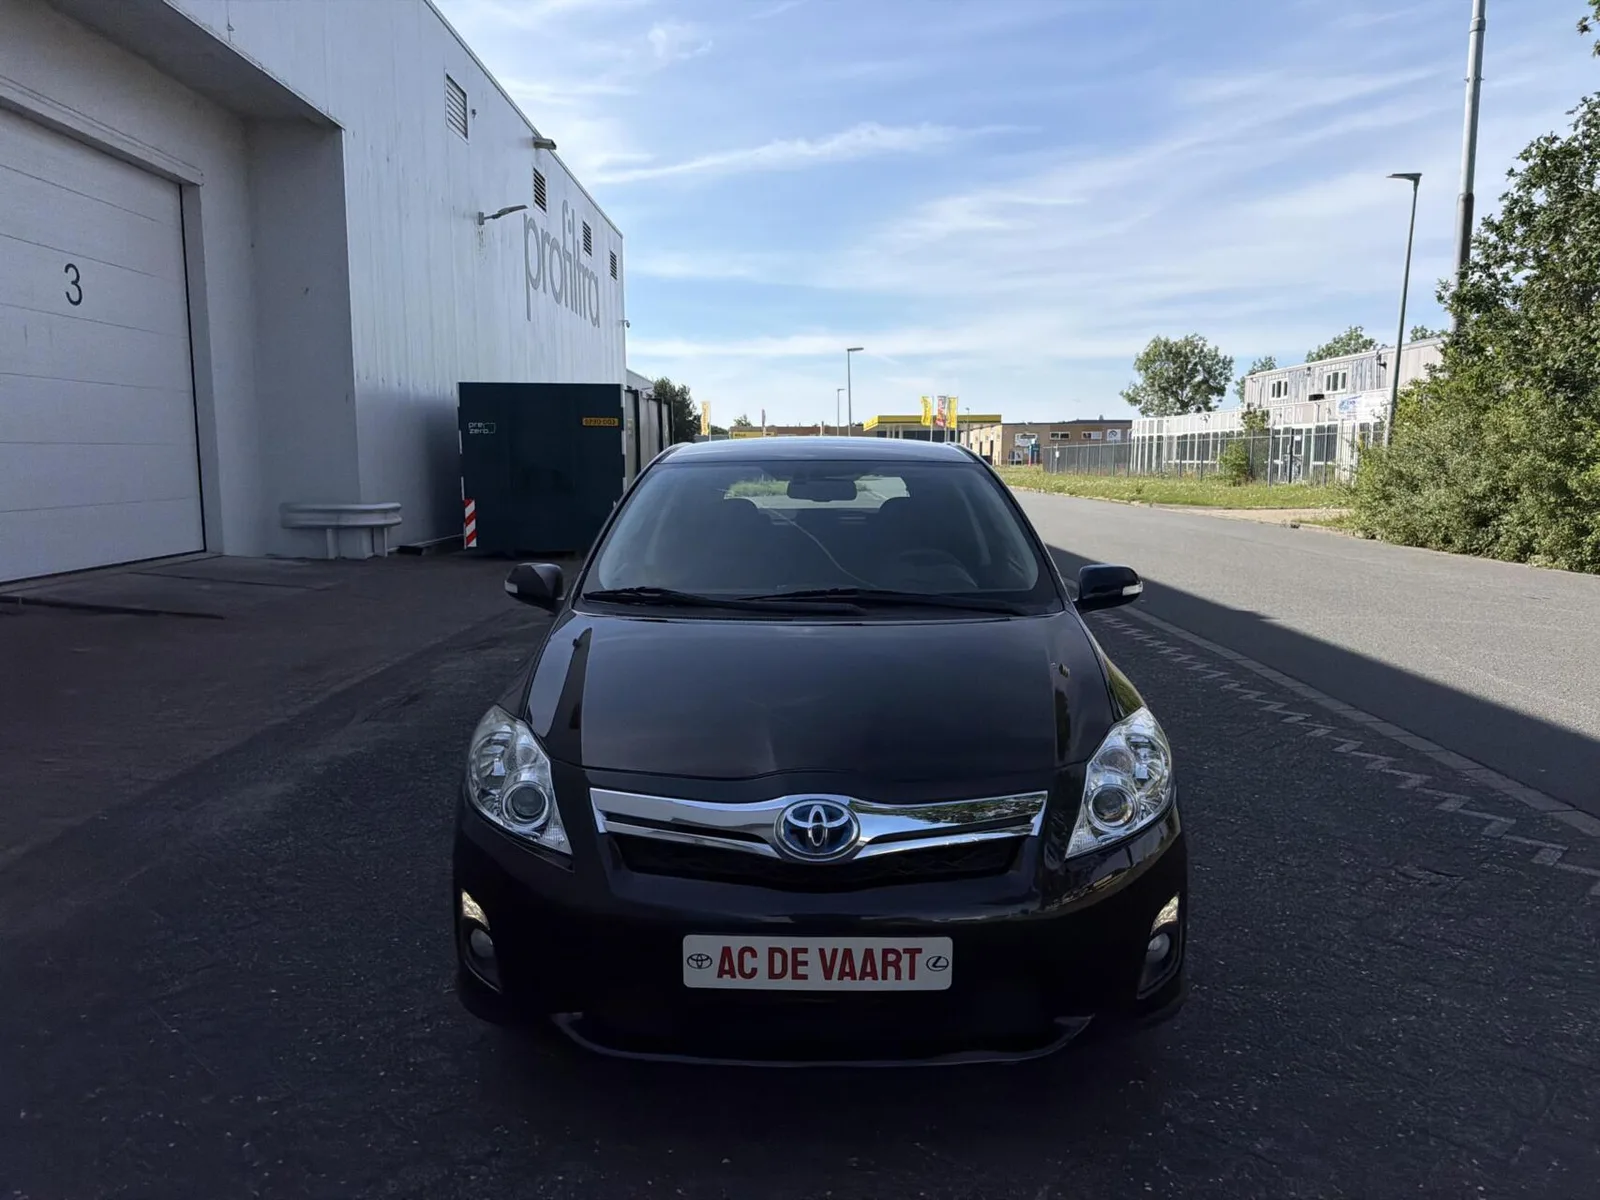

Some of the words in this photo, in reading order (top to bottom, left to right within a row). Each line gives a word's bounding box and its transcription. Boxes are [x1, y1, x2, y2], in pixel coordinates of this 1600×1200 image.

[64, 263, 83, 306] 3
[523, 200, 600, 328] profiltra
[716, 946, 758, 980] AC
[768, 947, 809, 980] DE
[818, 948, 923, 982] VAART
